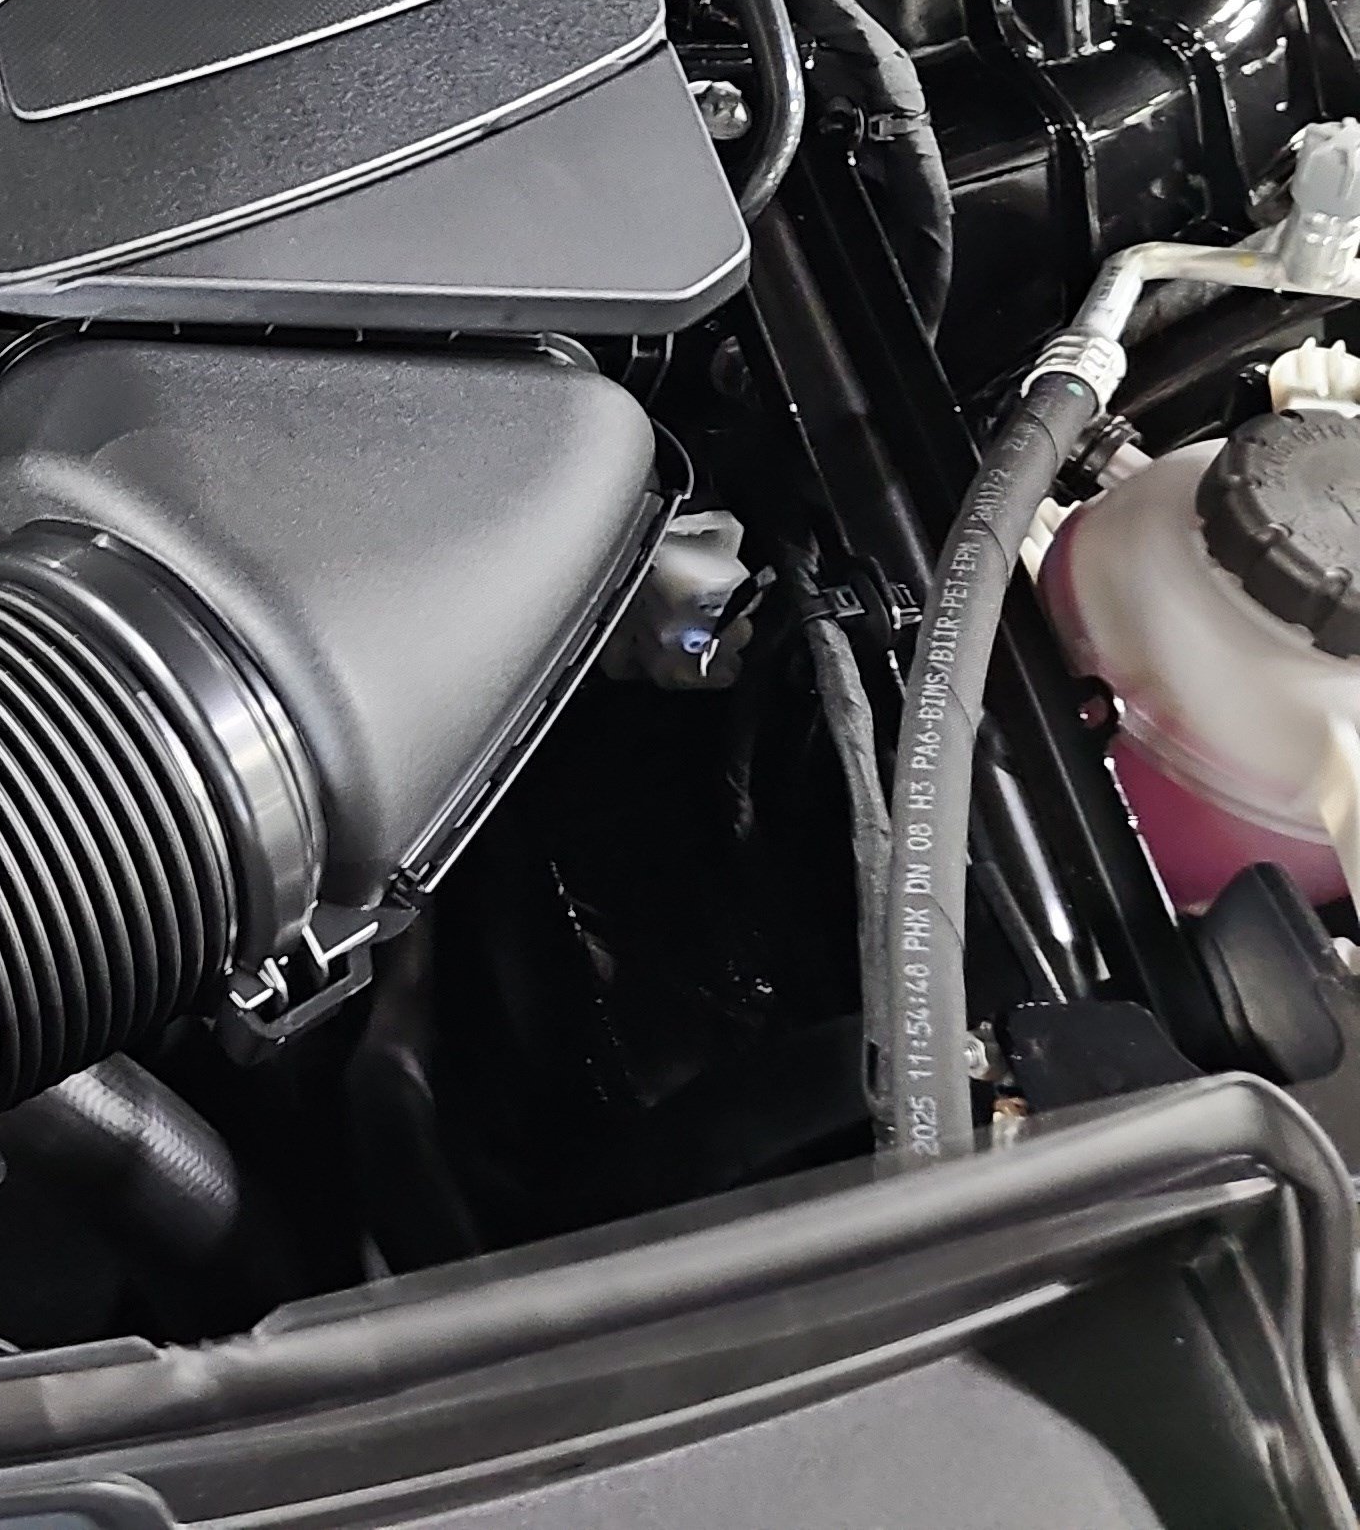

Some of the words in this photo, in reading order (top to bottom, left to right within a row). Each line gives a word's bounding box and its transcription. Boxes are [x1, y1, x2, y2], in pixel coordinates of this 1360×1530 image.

[908, 780, 937, 810] H3
[906, 822, 934, 852] 08
[905, 863, 933, 896] DN
[902, 906, 932, 952] PHX
[903, 962, 935, 1081] 11:54:48
[909, 1094, 940, 1157] 2025
